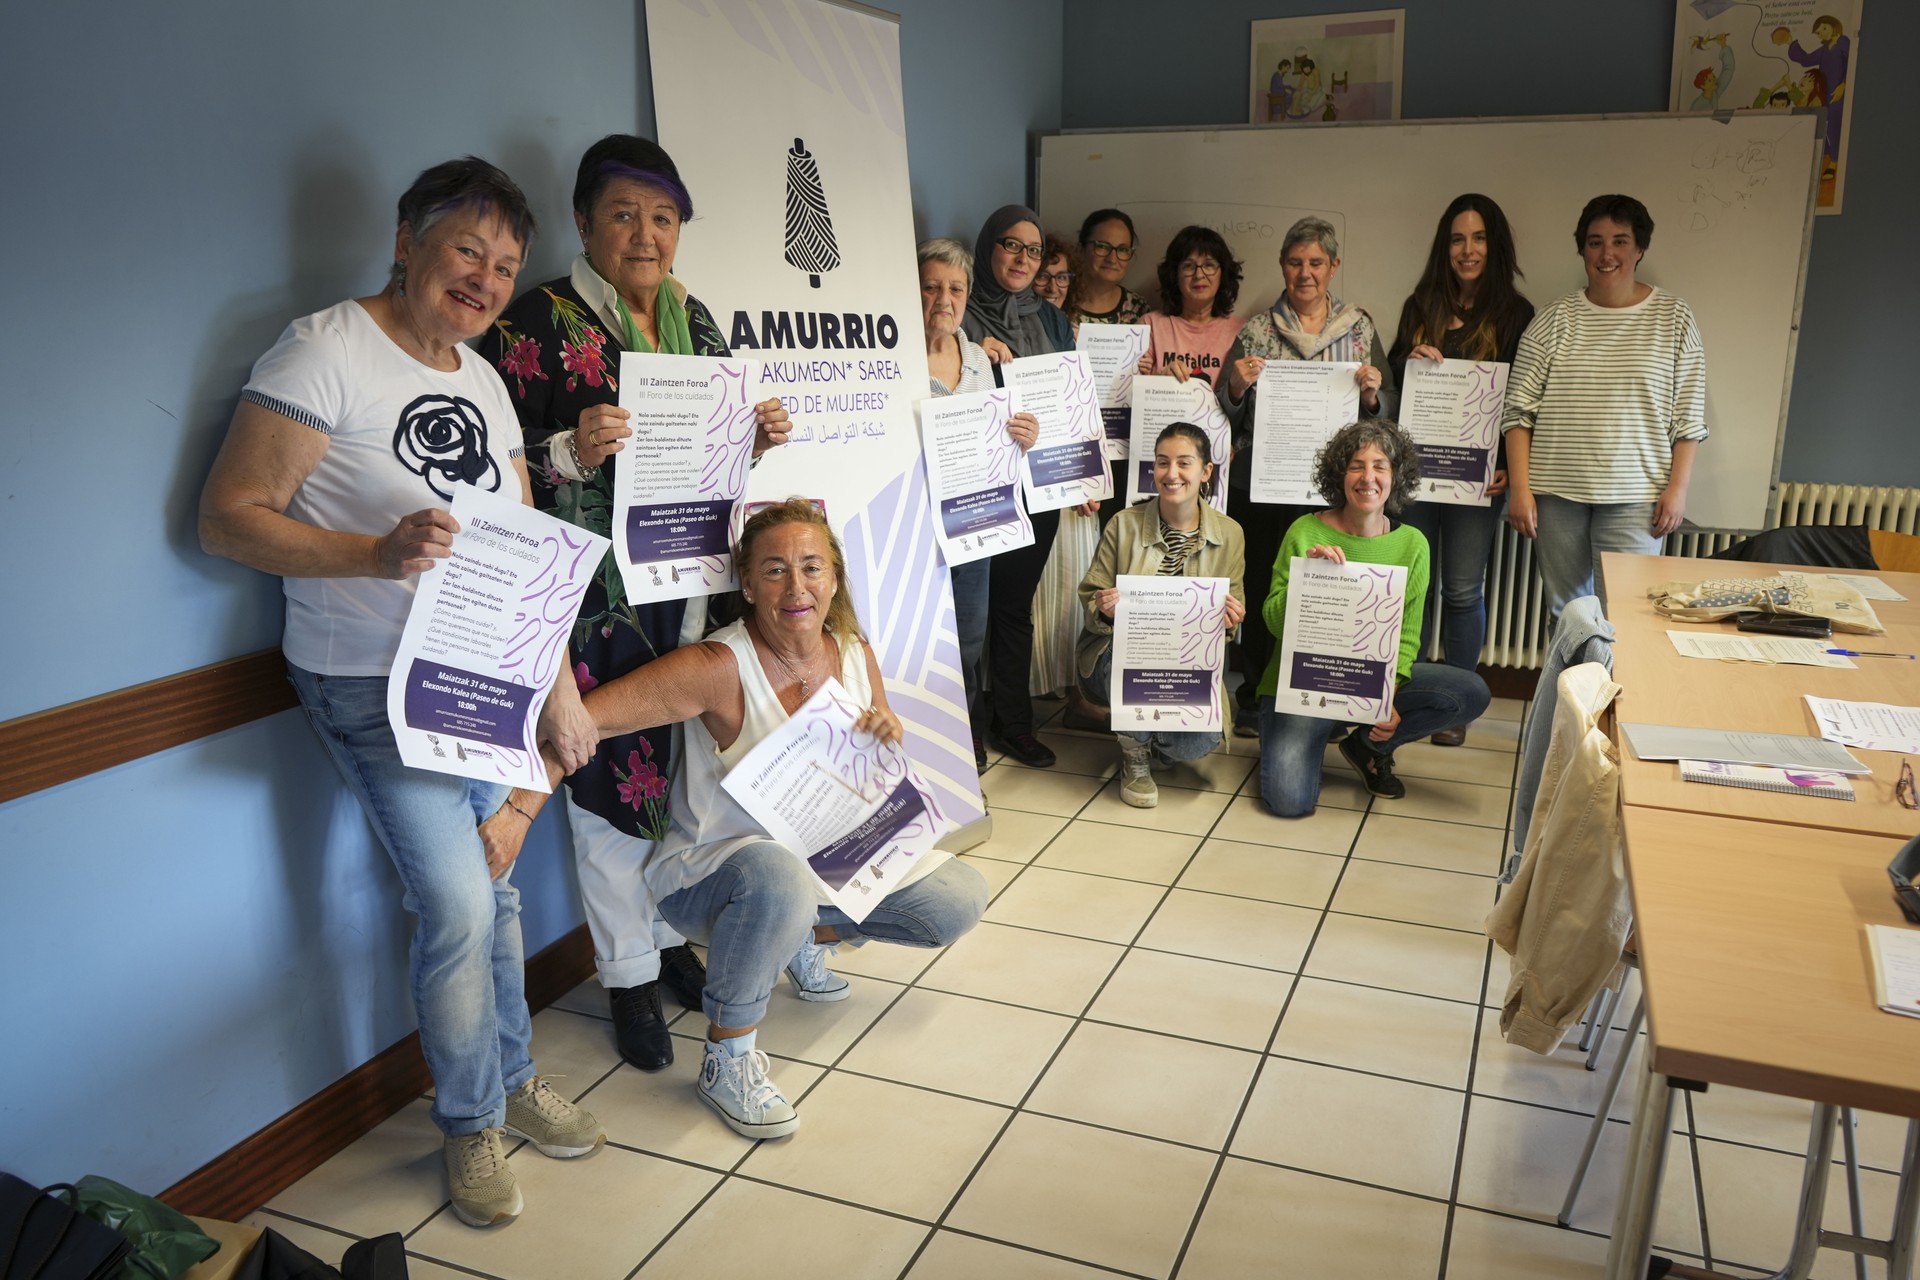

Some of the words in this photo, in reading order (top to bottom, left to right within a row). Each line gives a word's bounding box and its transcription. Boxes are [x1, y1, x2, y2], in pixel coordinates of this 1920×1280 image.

[730, 310, 898, 350] AMURRIO
[650, 378, 684, 387] Zaintzen
[687, 379, 708, 387] Foroa
[760, 361, 852, 384] AKUMEON
[858, 360, 902, 380] SAREA
[647, 391, 662, 399] Foro
[780, 396, 799, 414] ED
[804, 394, 822, 413] DE
[818, 422, 859, 444] التواصل
[862, 421, 886, 440] شبكة
[471, 518, 481, 527] III
[481, 521, 514, 538] Zaintzen
[515, 533, 539, 548] Foroa
[469, 532, 486, 544] Foro
[486, 539, 496, 548] de
[497, 542, 508, 552] los
[509, 548, 540, 563] cuidados
[452, 552, 464, 560] Nola
[464, 557, 481, 566] zaindu
[461, 566, 478, 575] zaindu
[479, 572, 502, 583] gaitzaten
[440, 590, 461, 599] zaintzen
[488, 604, 502, 612] duten
[452, 582, 485, 597] lan-baldintza
[486, 594, 503, 603] dituzte
[437, 599, 466, 610] pertsonek?
[438, 672, 469, 685] Maiatzak
[488, 686, 507, 695] mayo
[422, 681, 451, 693] Elexondo
[452, 688, 470, 697] Kalea
[470, 692, 490, 702] (Paseo
[500, 700, 514, 709] Guk)
[458, 701, 477, 711] 18:00h
